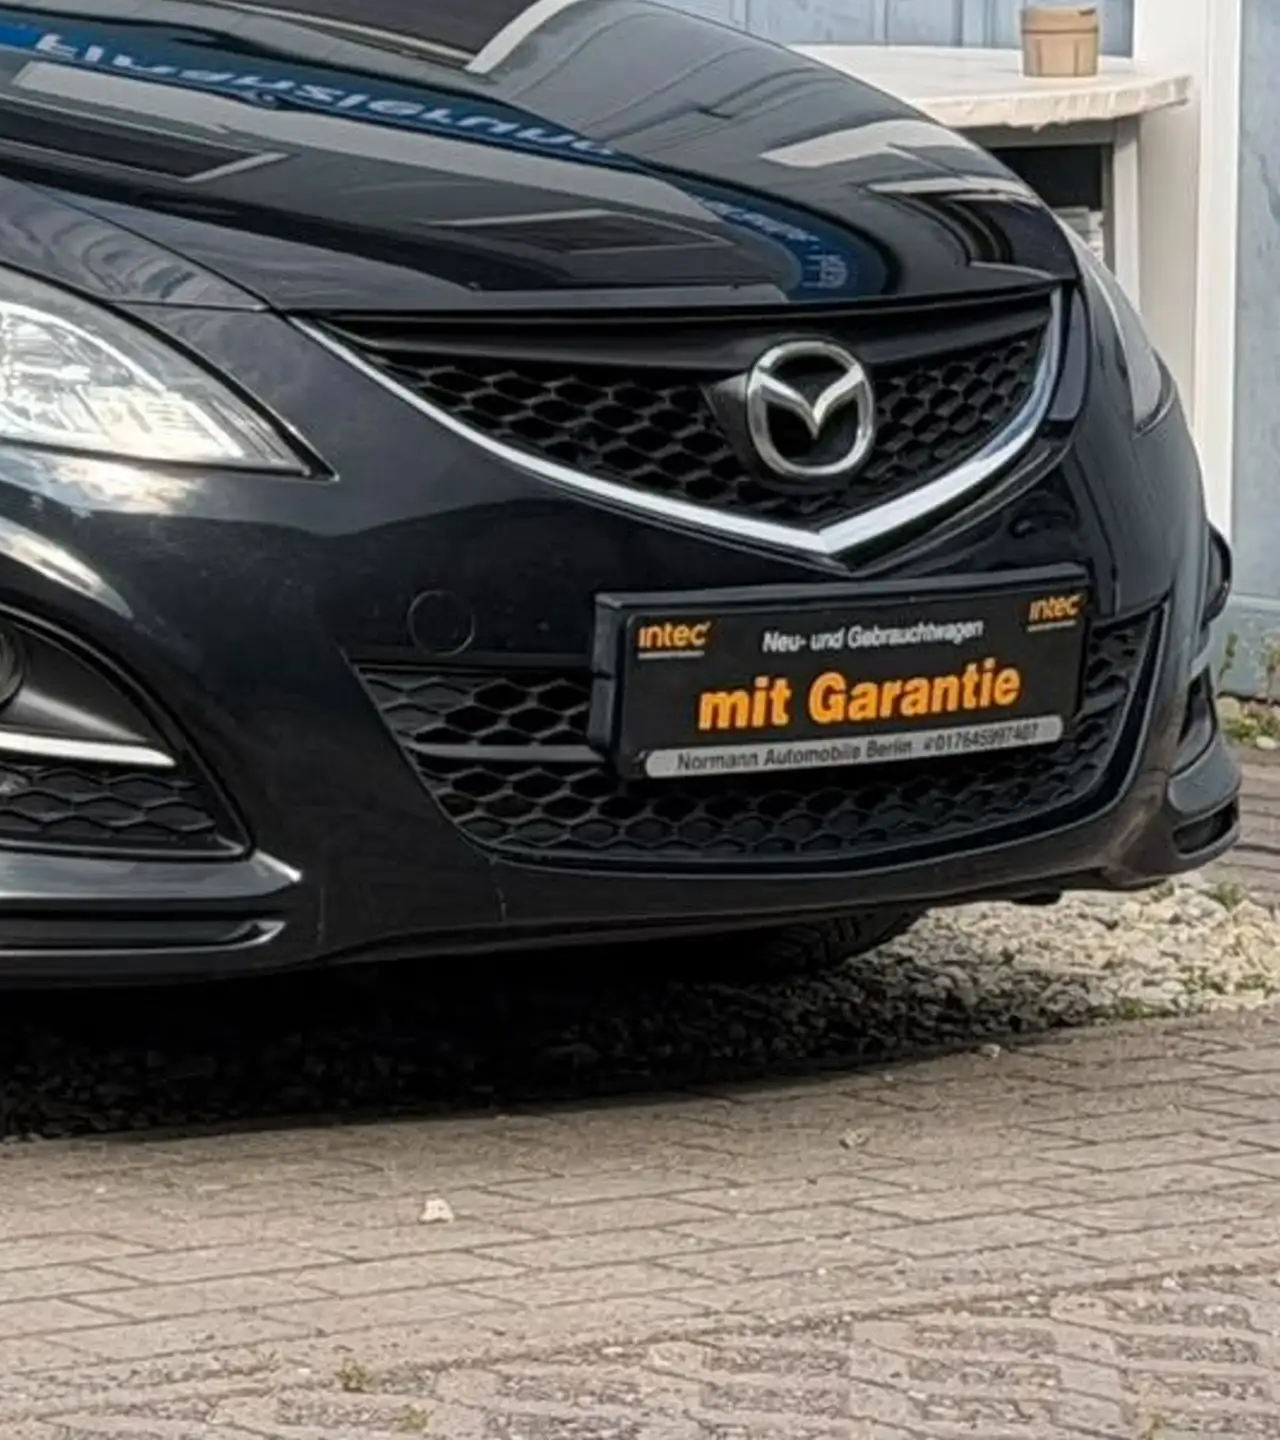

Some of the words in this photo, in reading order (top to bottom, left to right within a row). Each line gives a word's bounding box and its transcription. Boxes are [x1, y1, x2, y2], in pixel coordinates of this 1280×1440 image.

[761, 629, 808, 653] Neu-
[809, 626, 846, 651] und
[847, 620, 985, 646] Gebrauchtwagen
[697, 675, 792, 731] mit
[808, 657, 1022, 725] Garantie
[676, 751, 760, 771] Normann
[763, 743, 861, 767] Automobile
[866, 738, 913, 758] Berlin
